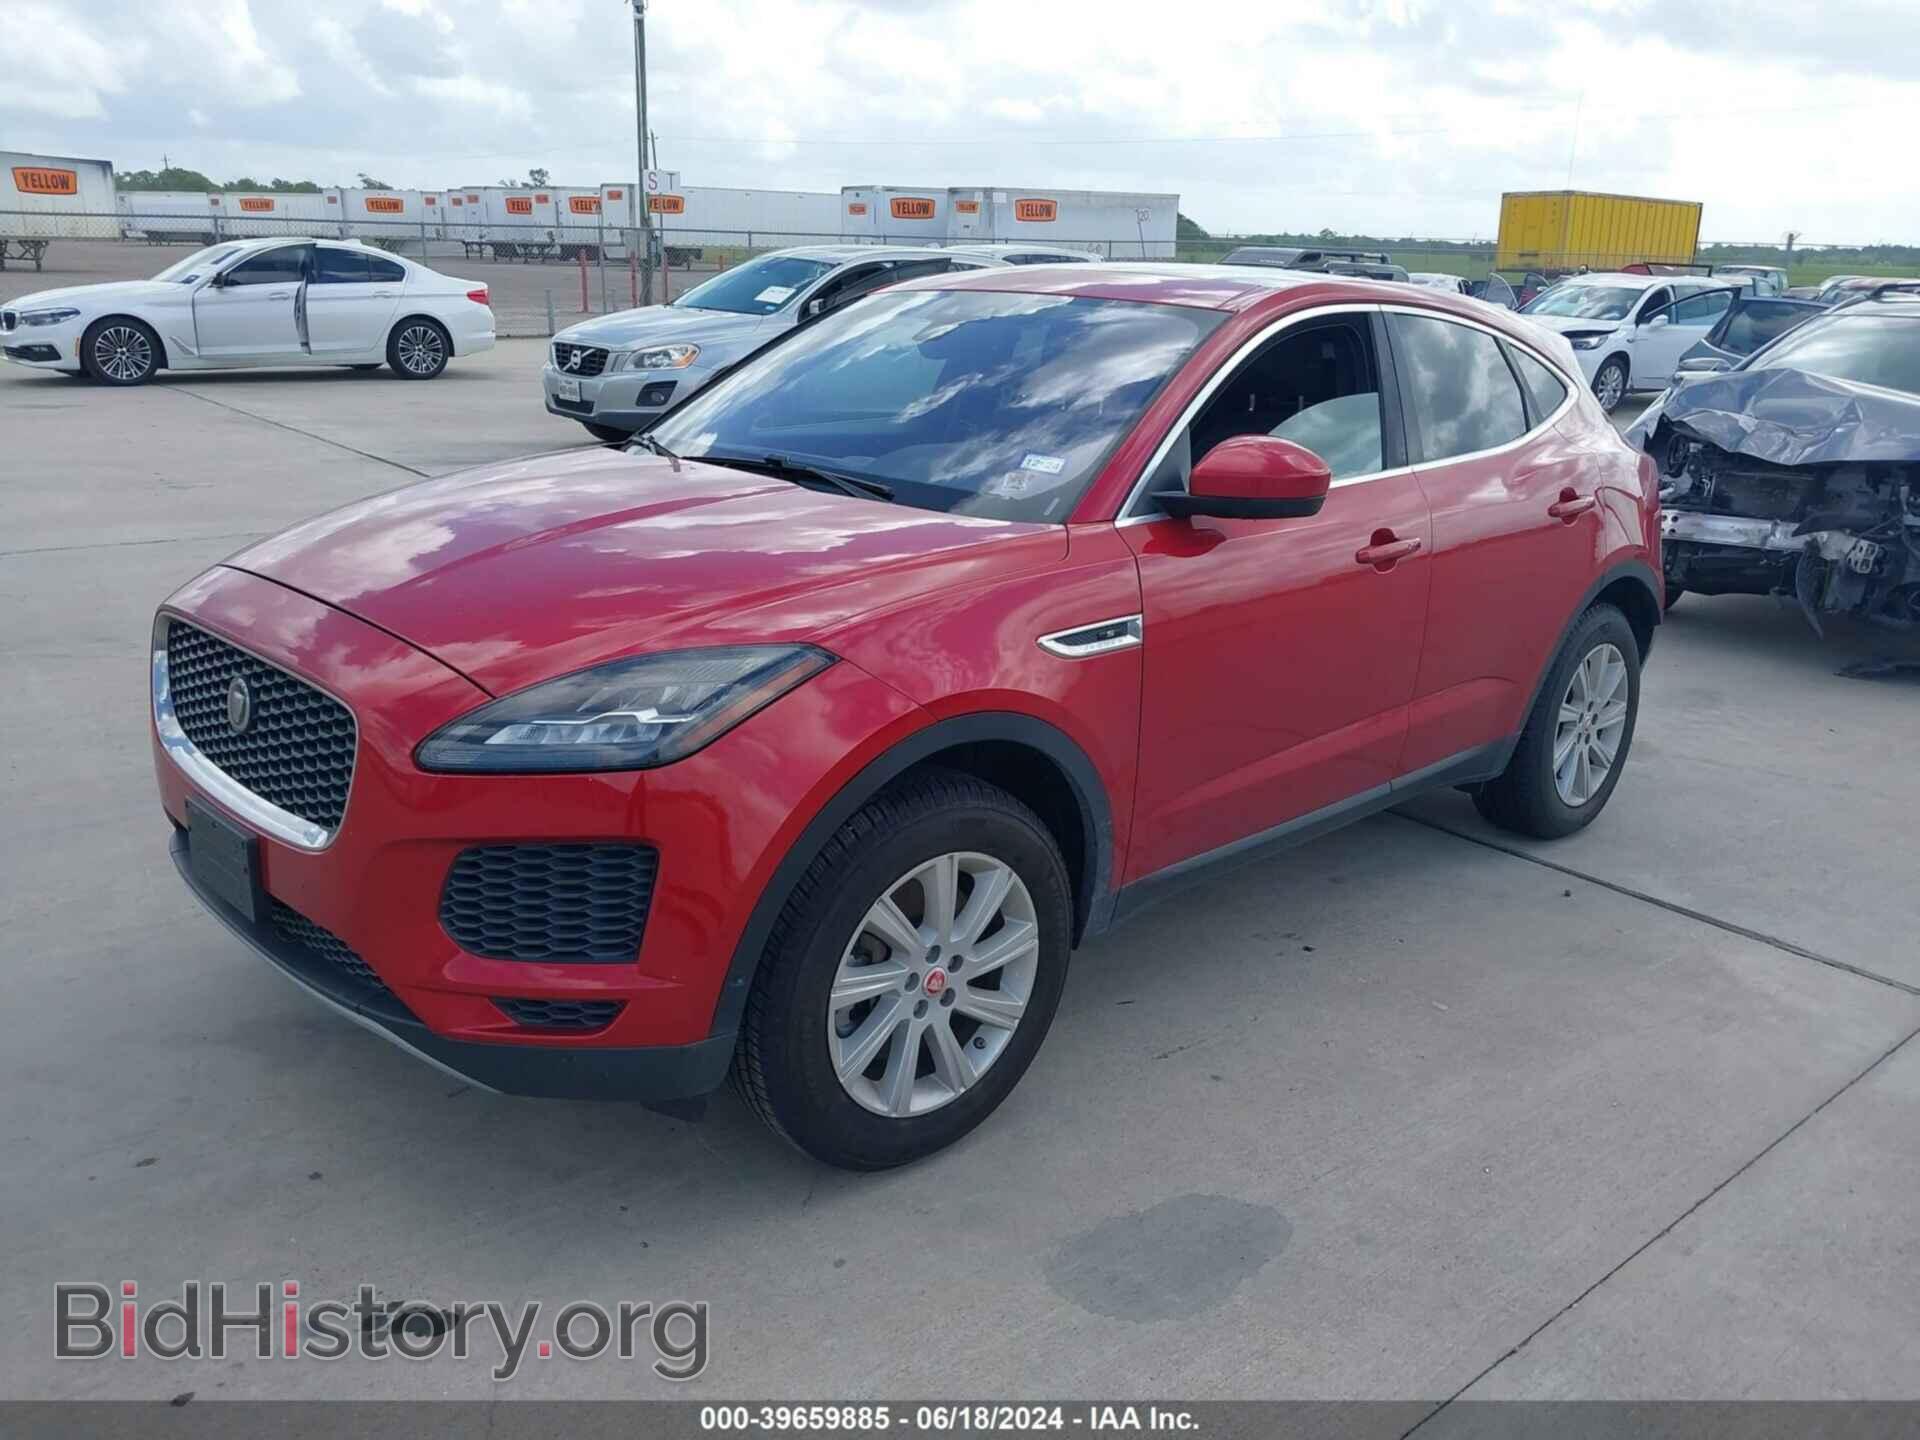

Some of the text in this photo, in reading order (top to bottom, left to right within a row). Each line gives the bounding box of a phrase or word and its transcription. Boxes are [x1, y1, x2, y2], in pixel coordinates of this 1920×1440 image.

[21, 171, 70, 191] YELLOW
[647, 171, 658, 190] S
[666, 172, 676, 191] T
[370, 199, 400, 210] YELLOW
[896, 200, 930, 216] YELLOW
[1019, 202, 1053, 217] YELLOW
